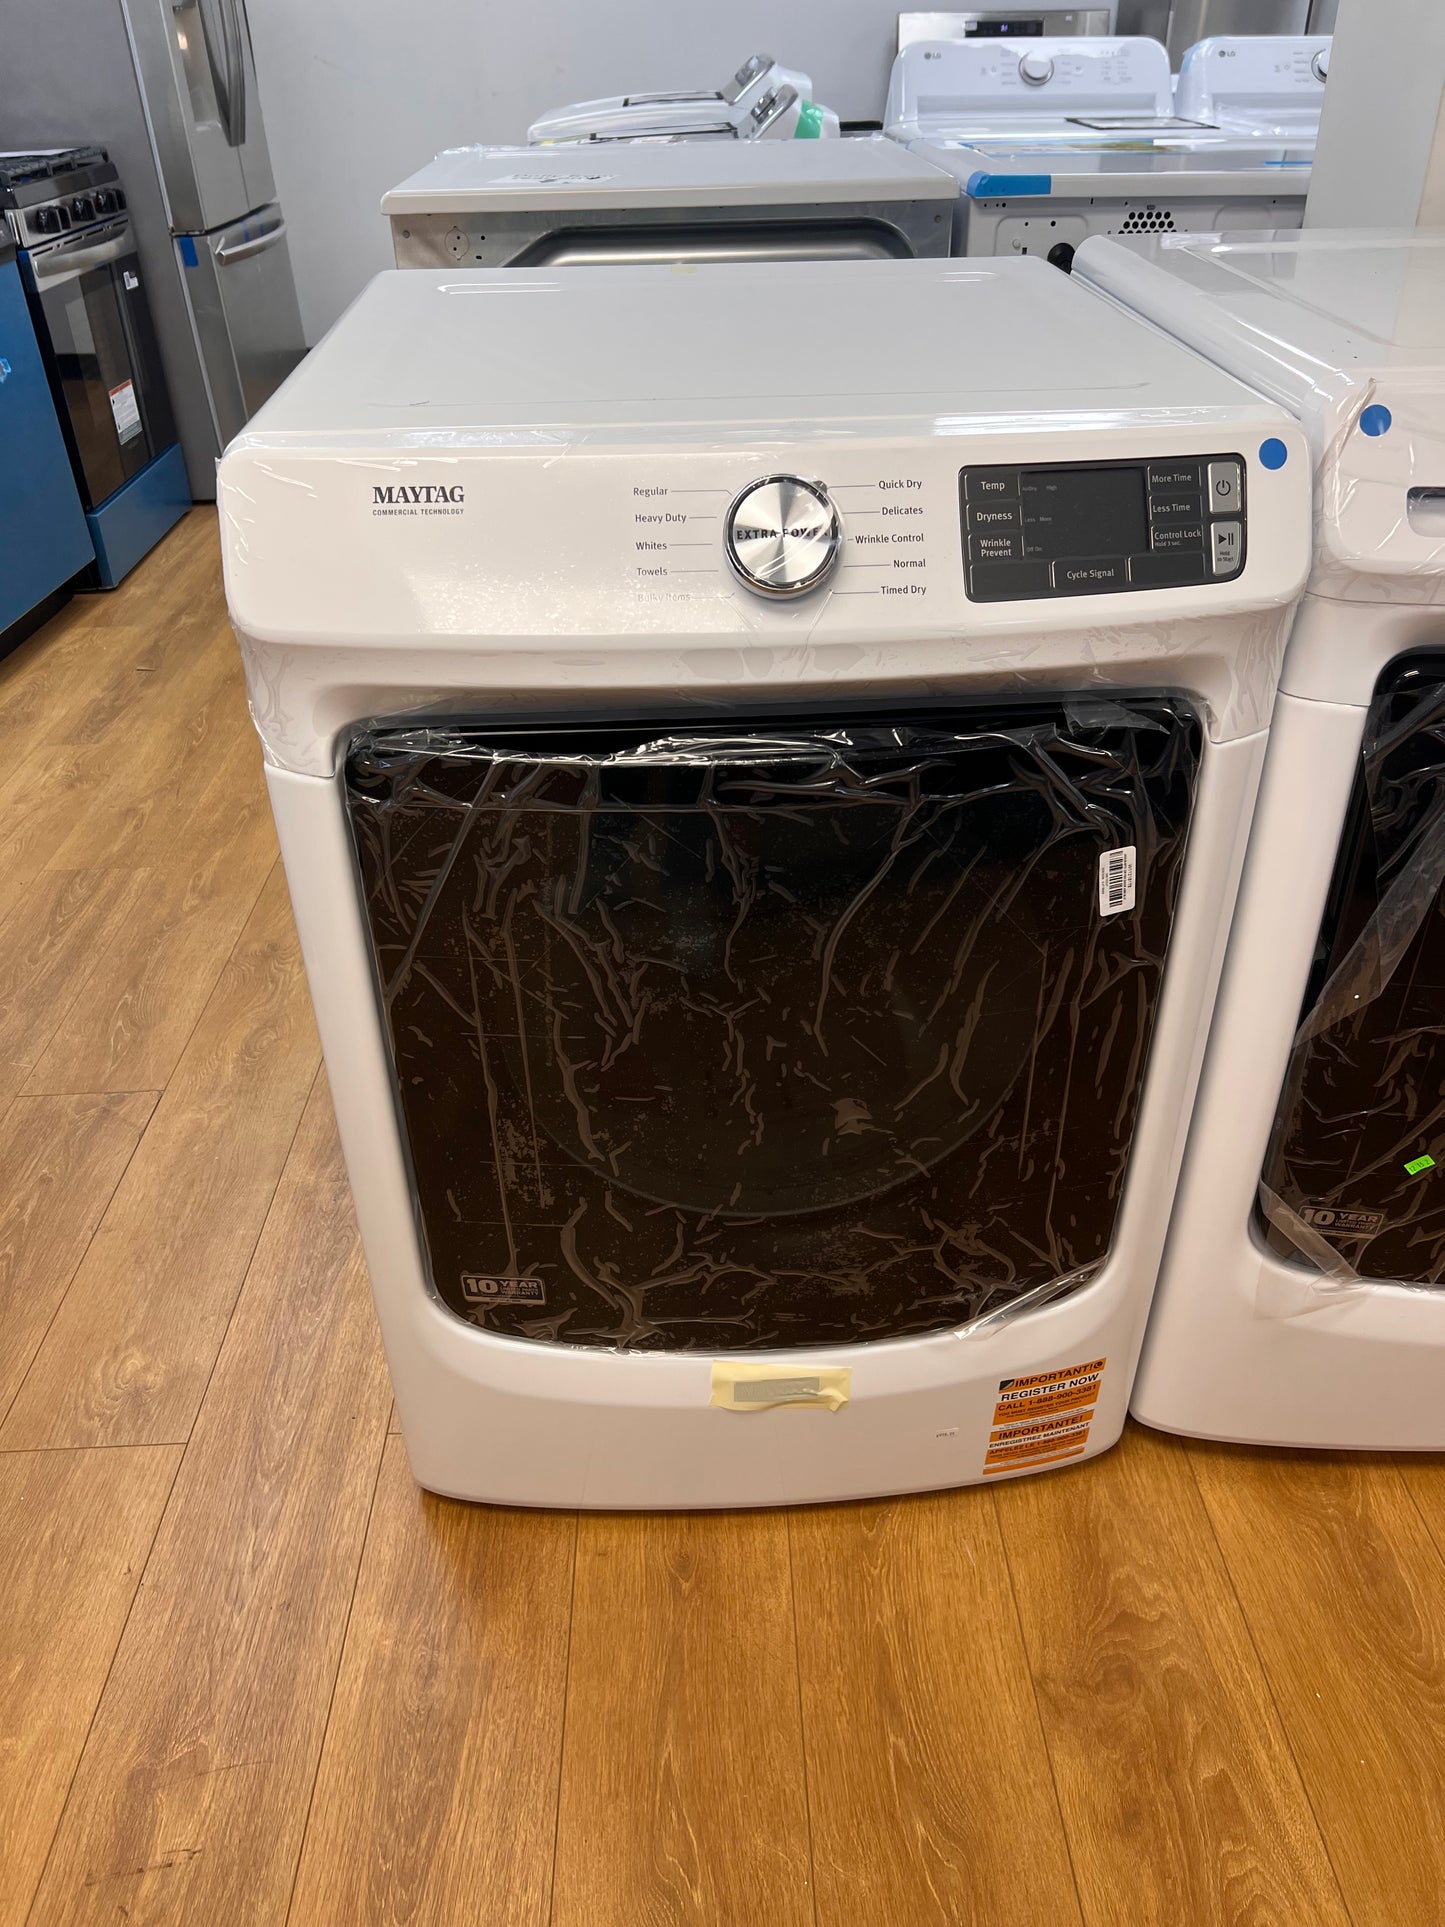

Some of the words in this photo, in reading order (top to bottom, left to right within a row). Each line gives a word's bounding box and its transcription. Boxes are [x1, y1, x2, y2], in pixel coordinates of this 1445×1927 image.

[1152, 475, 1172, 483] More
[1173, 474, 1192, 482] Time
[878, 480, 905, 490] Quick
[906, 479, 922, 490] Dry
[980, 481, 1005, 492] Temp
[372, 486, 464, 504] MAYTAG
[633, 486, 668, 498] Regular
[882, 506, 924, 516] Delicates
[1152, 504, 1170, 512] Less
[1171, 504, 1190, 512] Time
[635, 514, 664, 524] Heavy
[665, 513, 687, 524] Duty
[976, 512, 1013, 524] Dryness
[736, 529, 778, 540] EXTRA
[855, 534, 890, 544] Wrinkle
[891, 533, 924, 544] Control
[1154, 530, 1182, 540] Control
[1184, 529, 1202, 538] Lock
[636, 542, 668, 550] Whites
[980, 538, 1012, 548] Wrinkle
[981, 548, 1012, 558] Prevent
[894, 558, 926, 568] Normal
[637, 567, 668, 576] Towels
[1066, 570, 1088, 580] Cycle
[1089, 568, 1114, 579] Signal
[880, 585, 909, 595] Timed
[911, 584, 926, 596] Dry
[638, 593, 662, 603] Bulky
[665, 592, 691, 601] Items
[1304, 1208, 1336, 1226] 10
[1340, 1212, 1378, 1222] YEAR
[1334, 1222, 1376, 1230] WARRANTY
[466, 1278, 498, 1294] 10
[500, 1280, 538, 1288] YEAR
[1014, 1363, 1094, 1388] IMPORTANT!
[1001, 1382, 1066, 1402] REGISTER
[1069, 1373, 1100, 1388] NOW
[998, 1401, 1026, 1412] CALL
[1028, 1384, 1097, 1406] 1-888-900-3381
[998, 1416, 1084, 1440] IMPORTANTE!
[989, 1434, 1042, 1448] ENREGISTREZ
[1042, 1422, 1090, 1438] MAINTENANT
